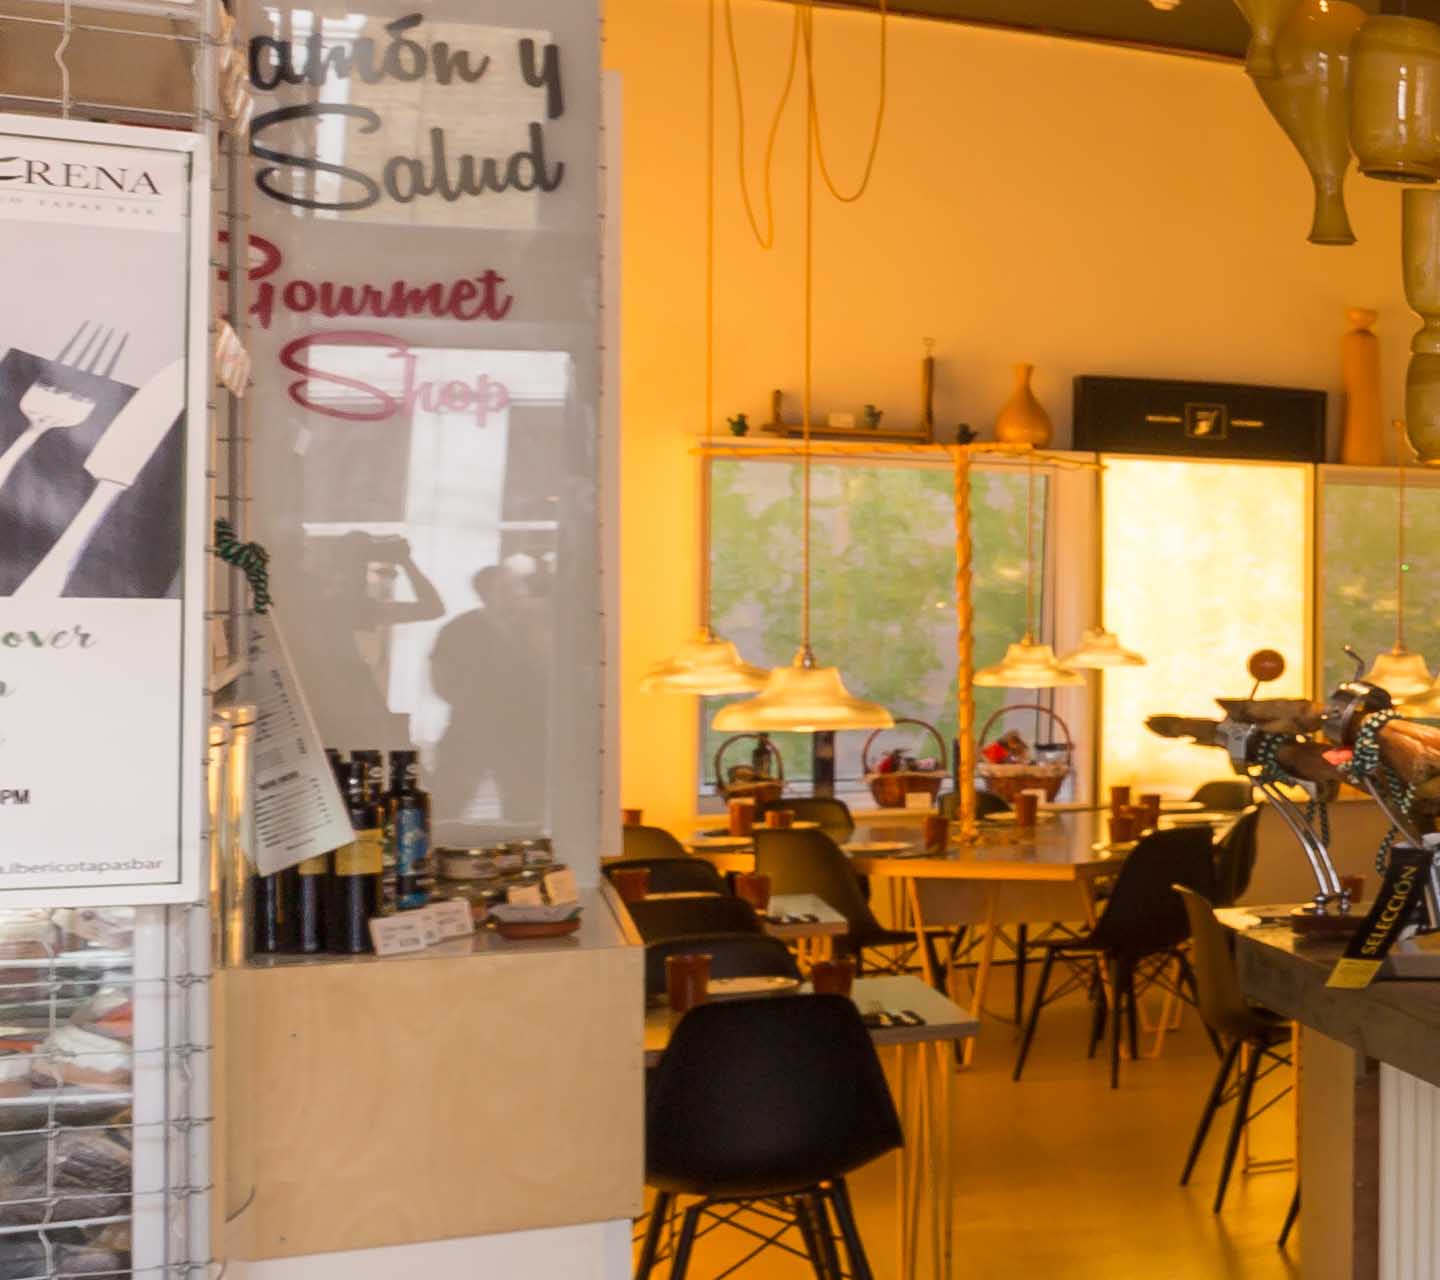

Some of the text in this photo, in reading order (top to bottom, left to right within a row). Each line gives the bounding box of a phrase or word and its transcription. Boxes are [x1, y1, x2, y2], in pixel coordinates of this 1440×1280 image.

[249, 14, 564, 119] amón y
[250, 102, 564, 211] Salud
[217, 229, 513, 330] Gourmet
[279, 329, 510, 427] Shop
[1360, 865, 1418, 956] SELECCIÓN
